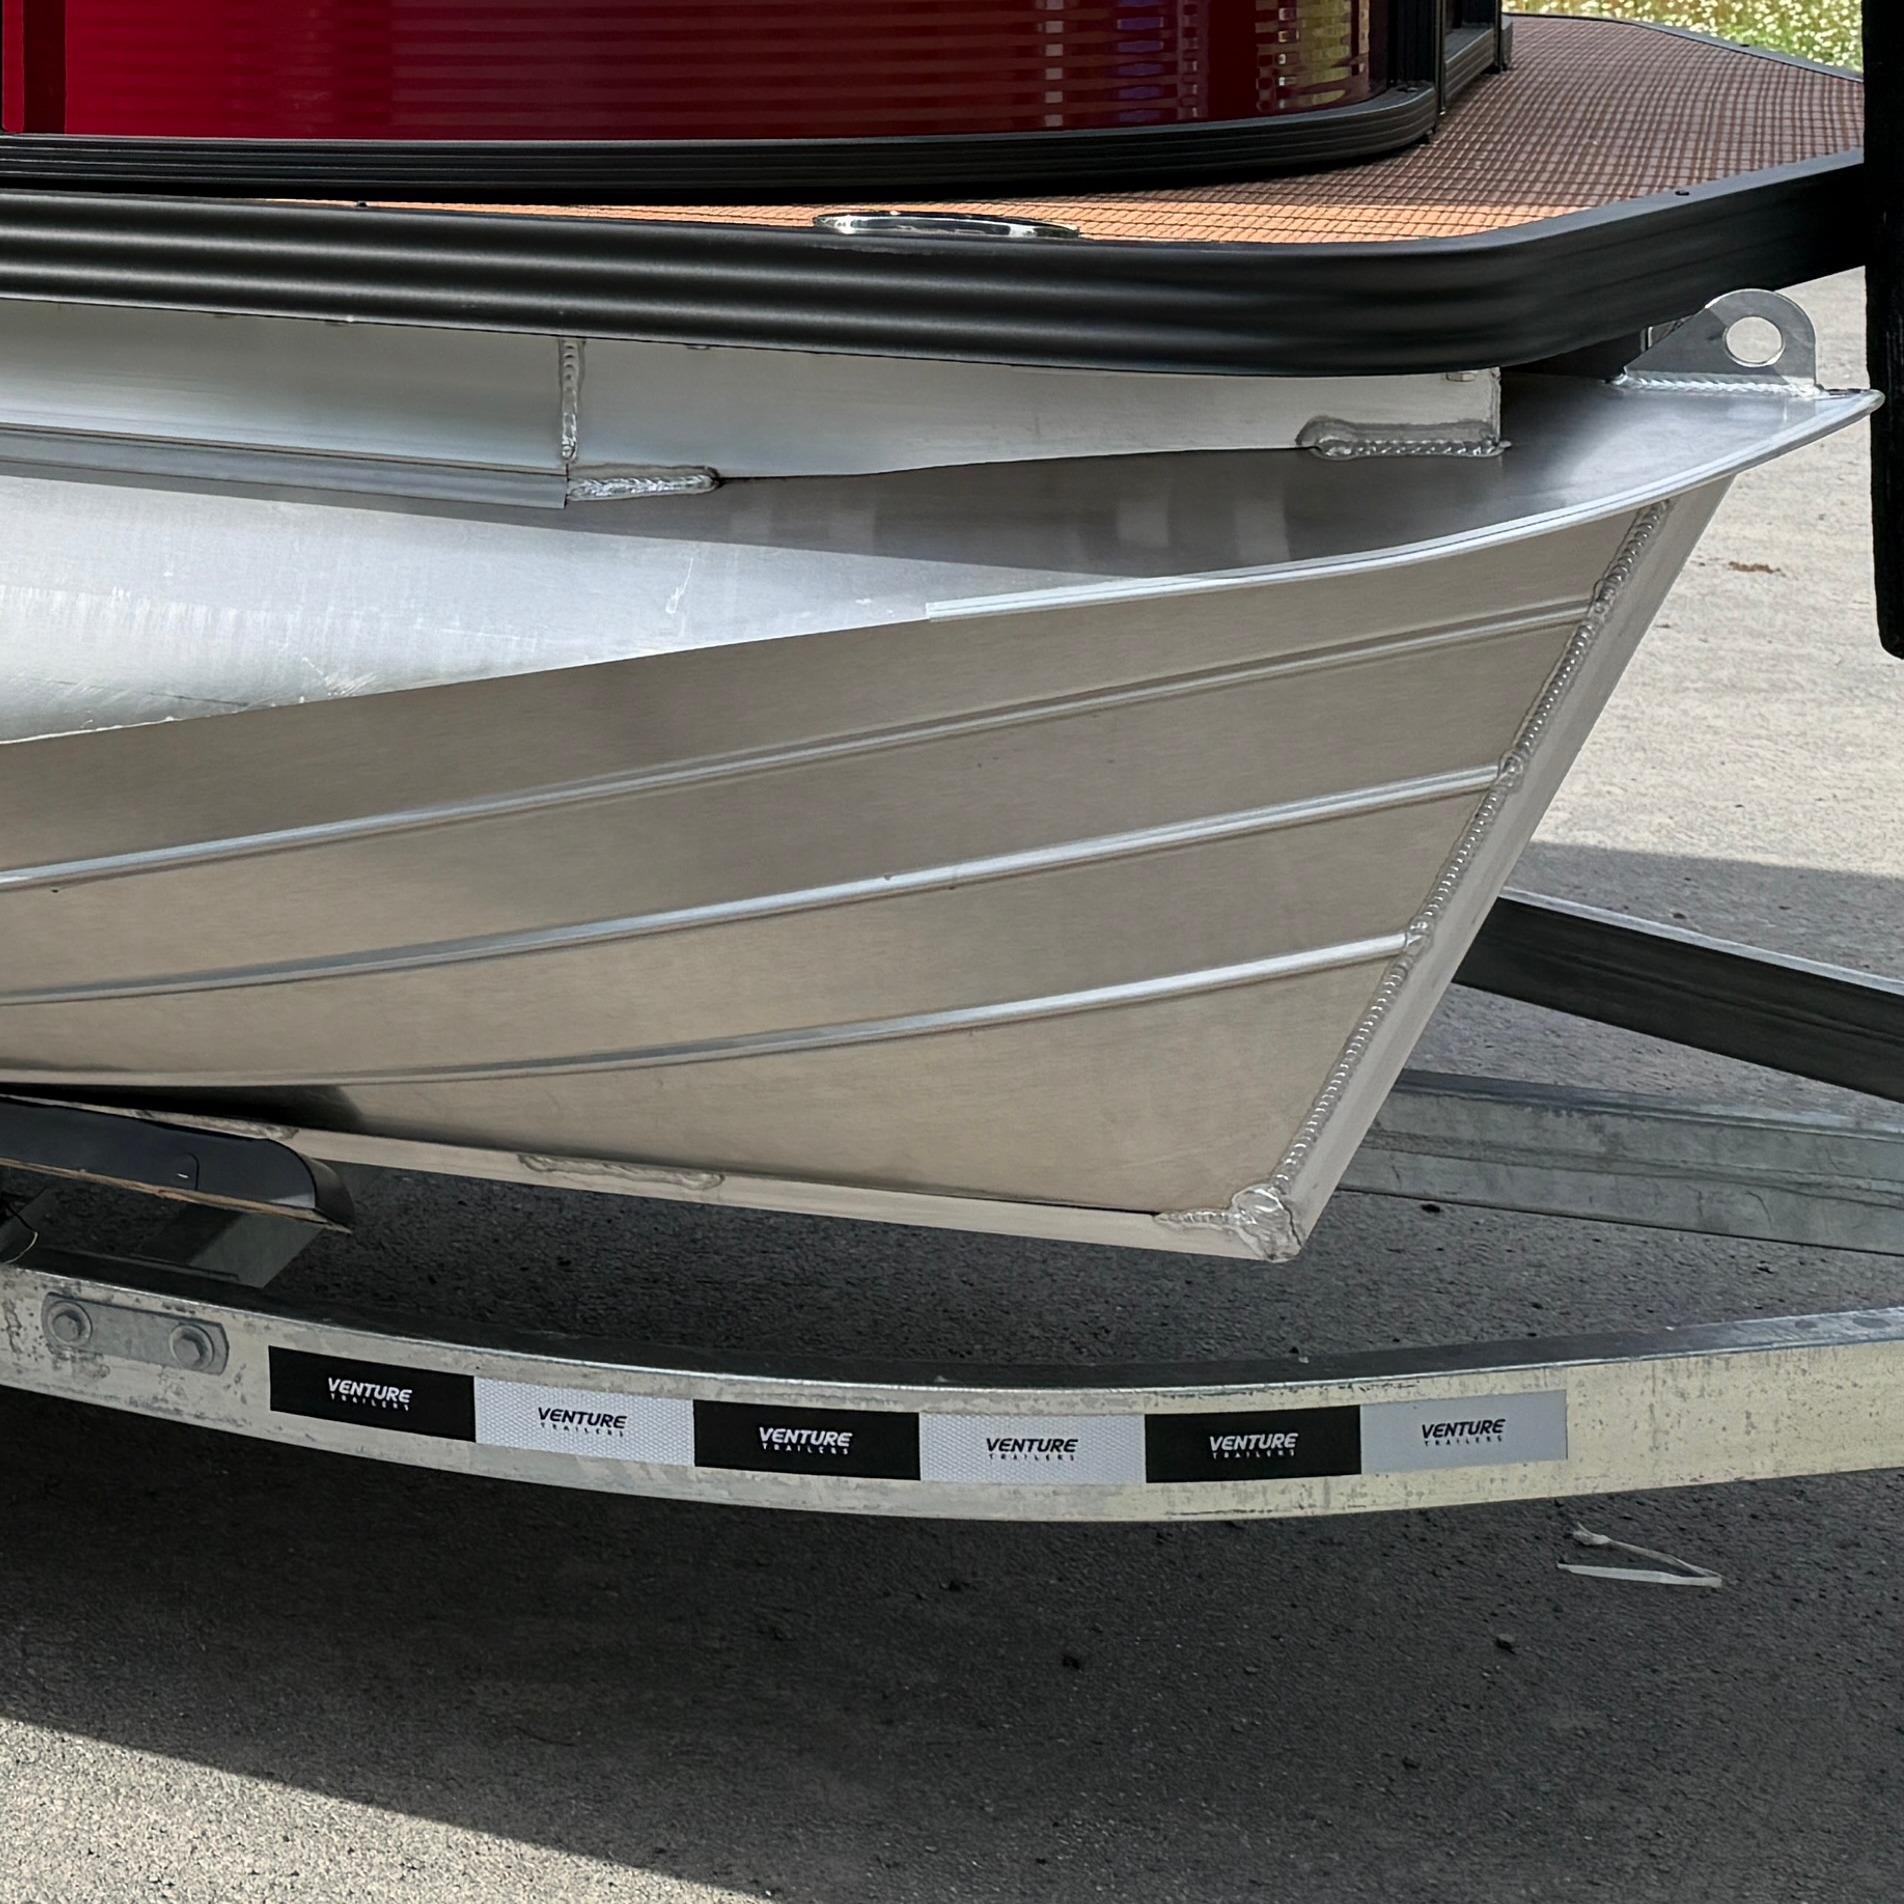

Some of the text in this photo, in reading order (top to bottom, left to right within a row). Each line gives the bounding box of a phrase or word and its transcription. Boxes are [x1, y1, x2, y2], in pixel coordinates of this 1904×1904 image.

[328, 1377, 413, 1403] VENTURE
[538, 1406, 628, 1429] VENTURE
[759, 1426, 853, 1447] VENTURE
[1421, 1418, 1506, 1439] VENTURE
[762, 1443, 848, 1455] TRAILERS
[986, 1437, 1079, 1453] VENTURE
[1209, 1432, 1299, 1452] VENTURE
